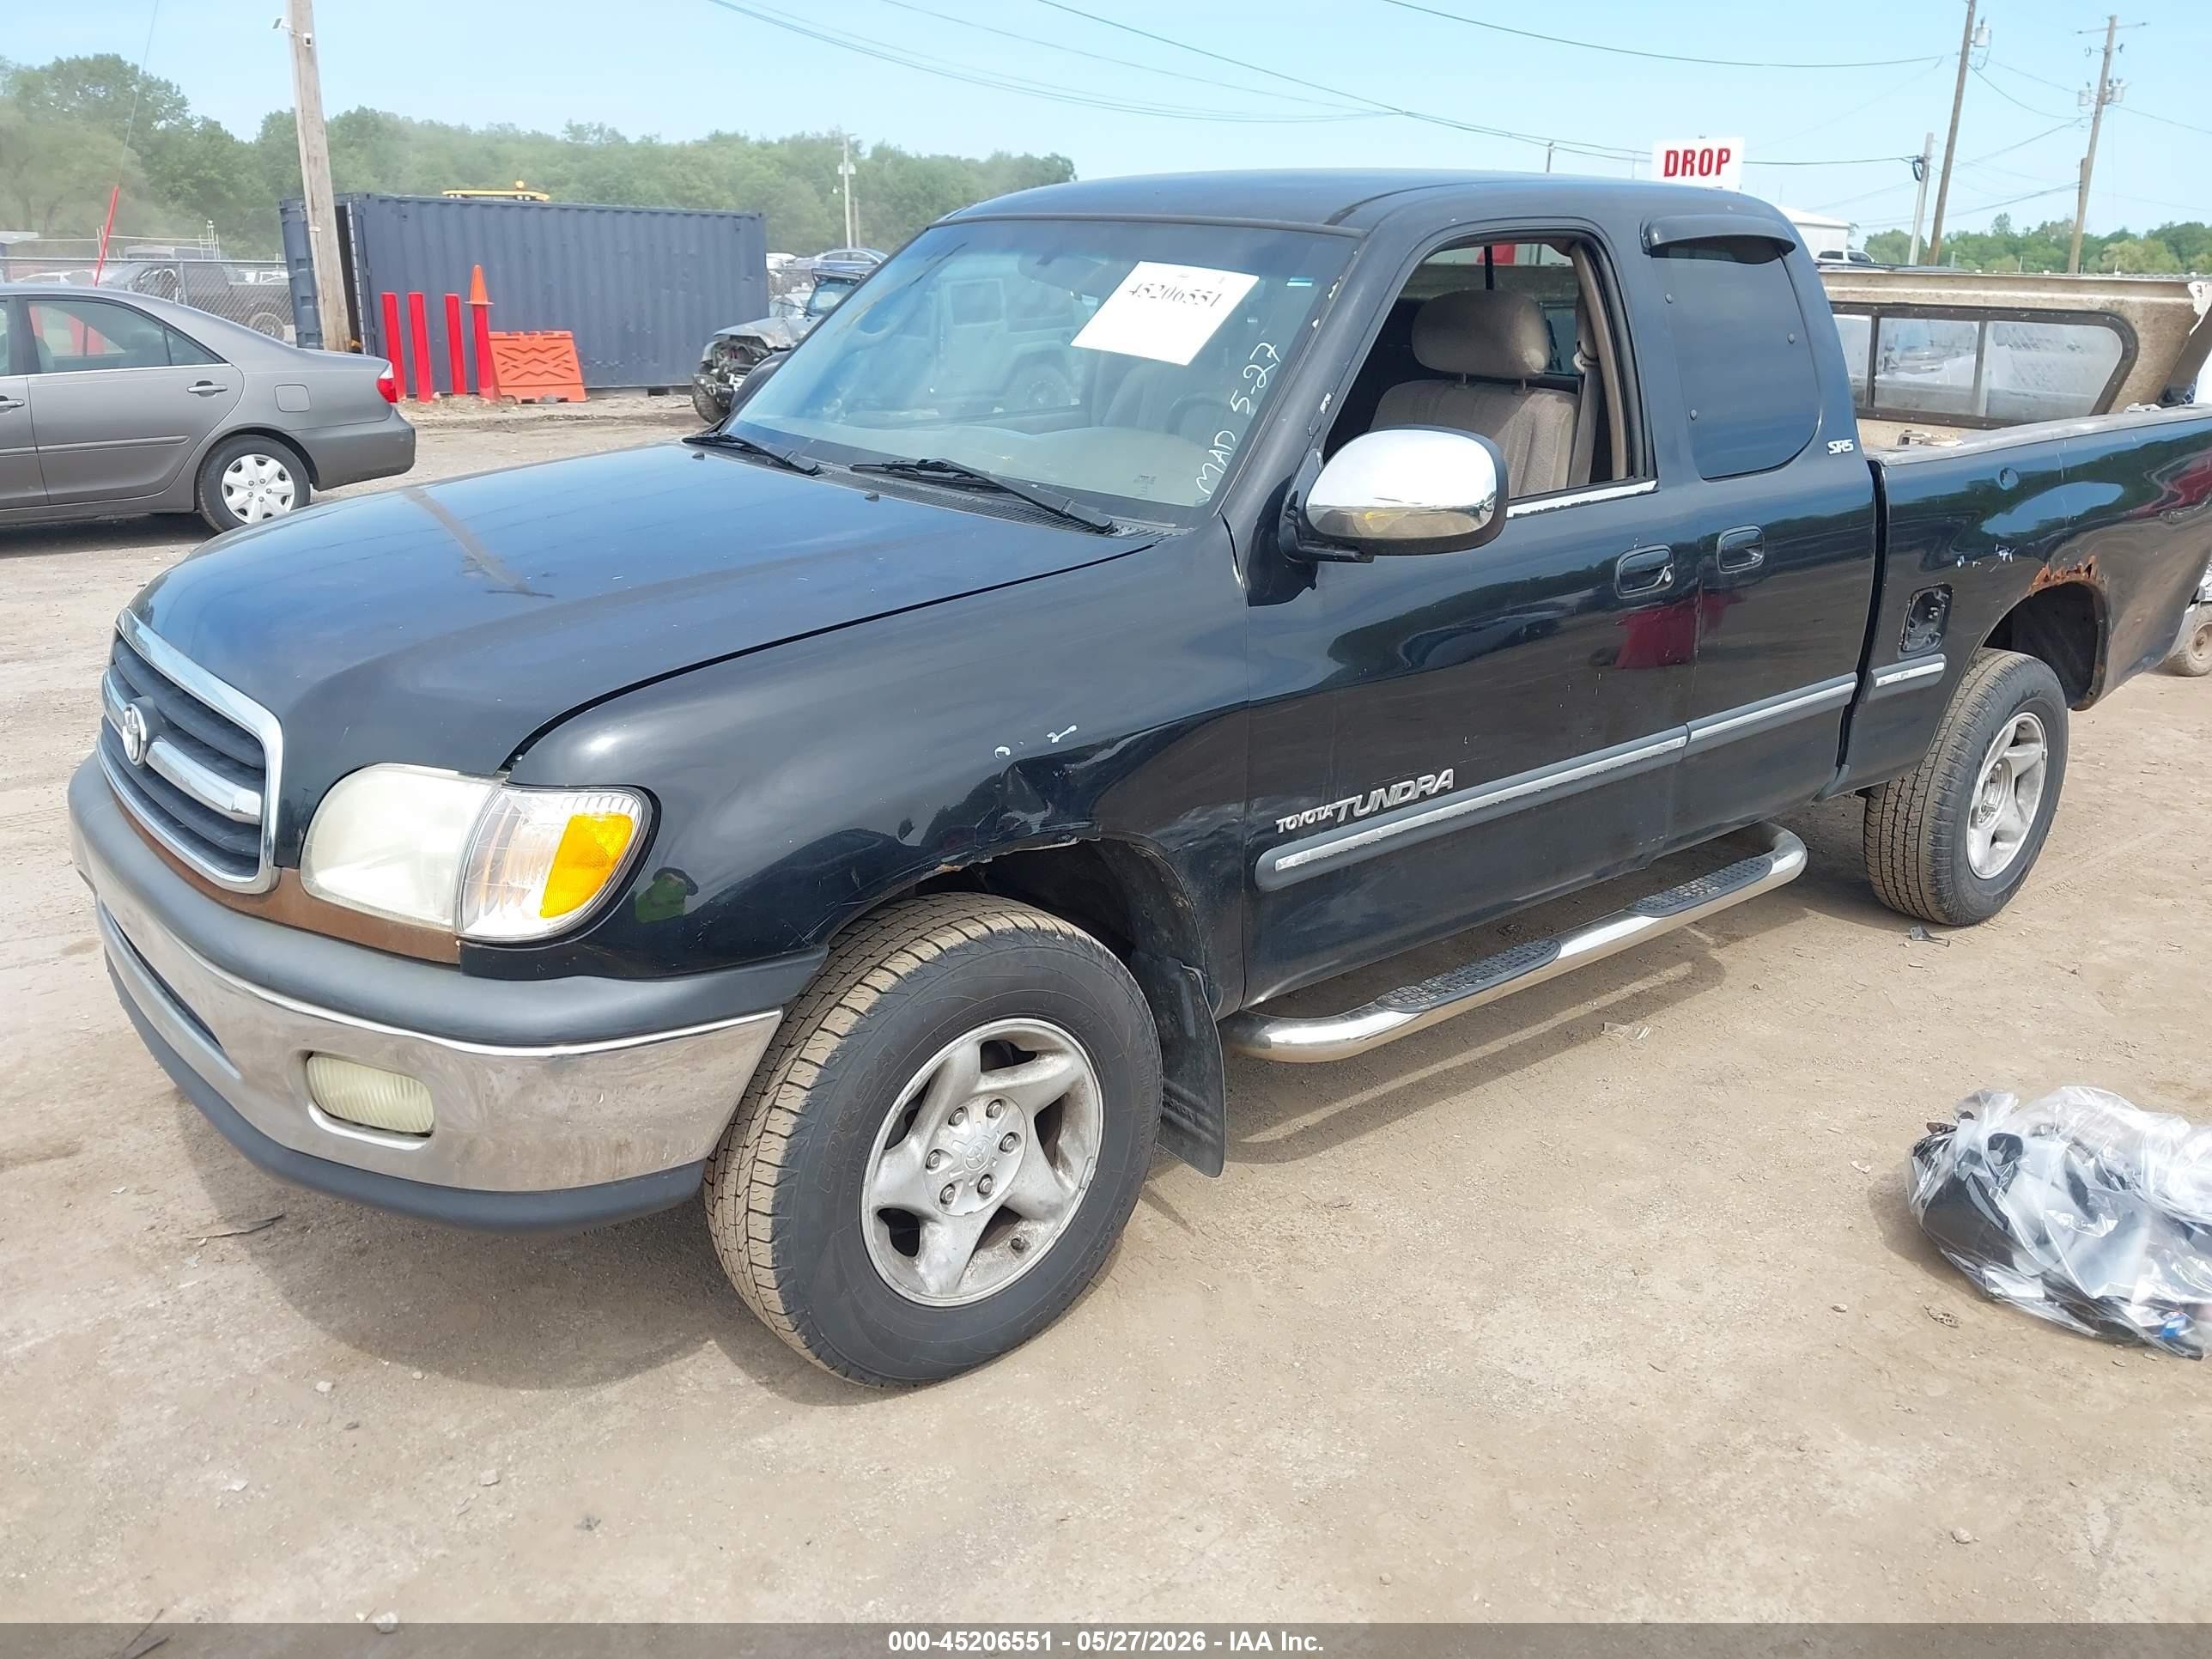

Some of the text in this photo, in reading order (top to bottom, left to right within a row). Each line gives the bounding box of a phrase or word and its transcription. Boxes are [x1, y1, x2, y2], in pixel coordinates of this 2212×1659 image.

[1664, 149, 1730, 177] DROP
[1128, 283, 1222, 307] 45206551
[1230, 342, 1280, 414] 5-27
[1827, 439, 1854, 454] SR5
[1275, 768, 1454, 834] TOYOTA TUNDRA
